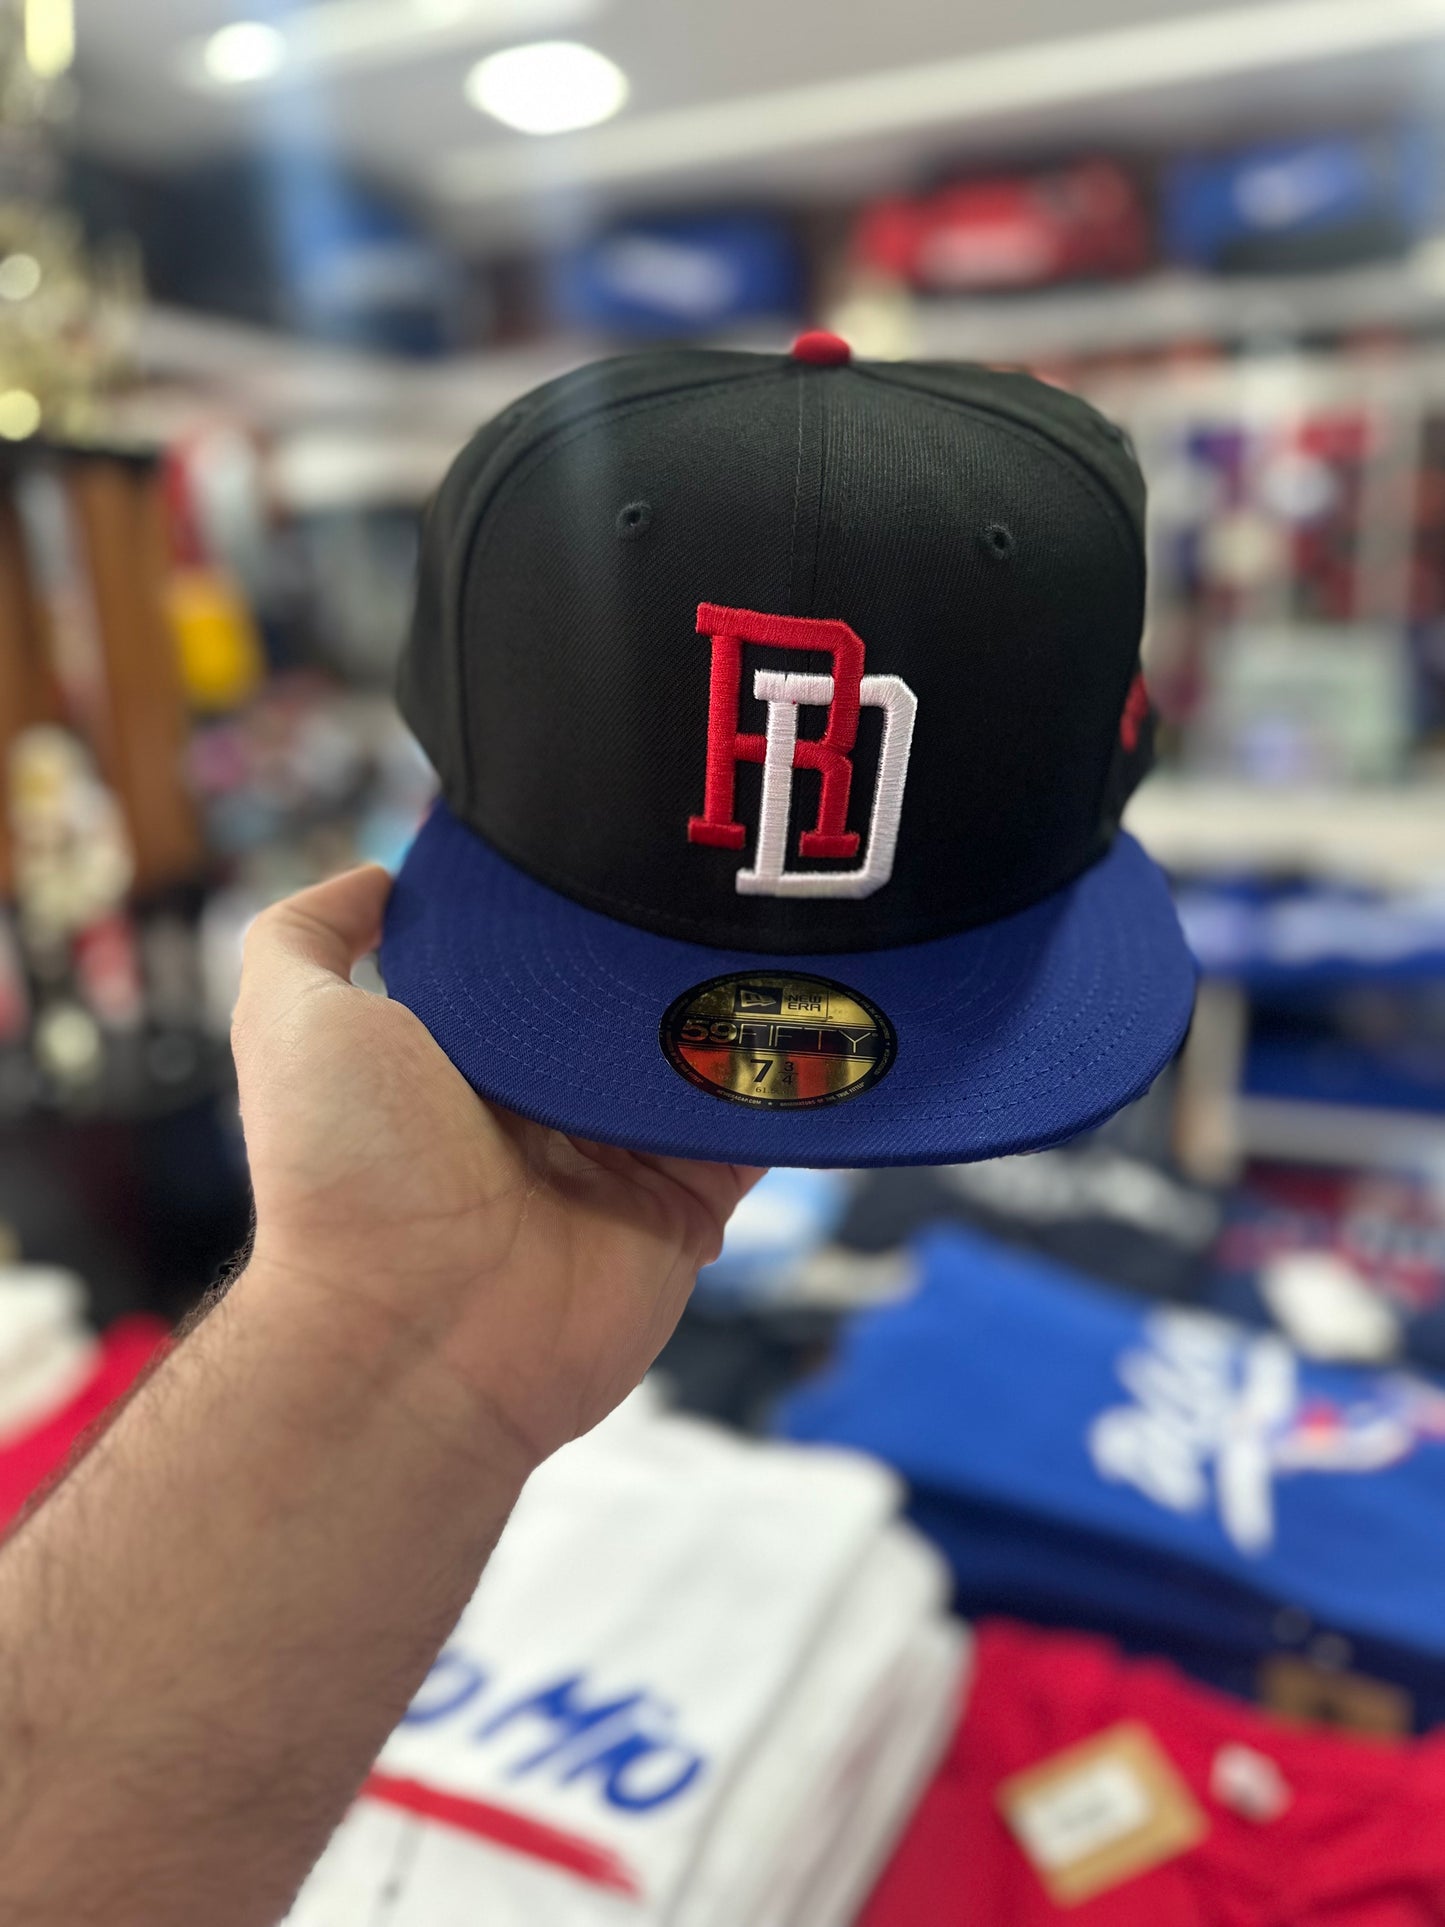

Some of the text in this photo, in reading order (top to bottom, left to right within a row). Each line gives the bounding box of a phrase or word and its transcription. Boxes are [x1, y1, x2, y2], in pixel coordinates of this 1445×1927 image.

[787, 994, 822, 1003] NEW
[787, 1002, 822, 1012] ERA
[681, 1019, 872, 1054] 59FIFTY
[750, 1059, 774, 1083] 7
